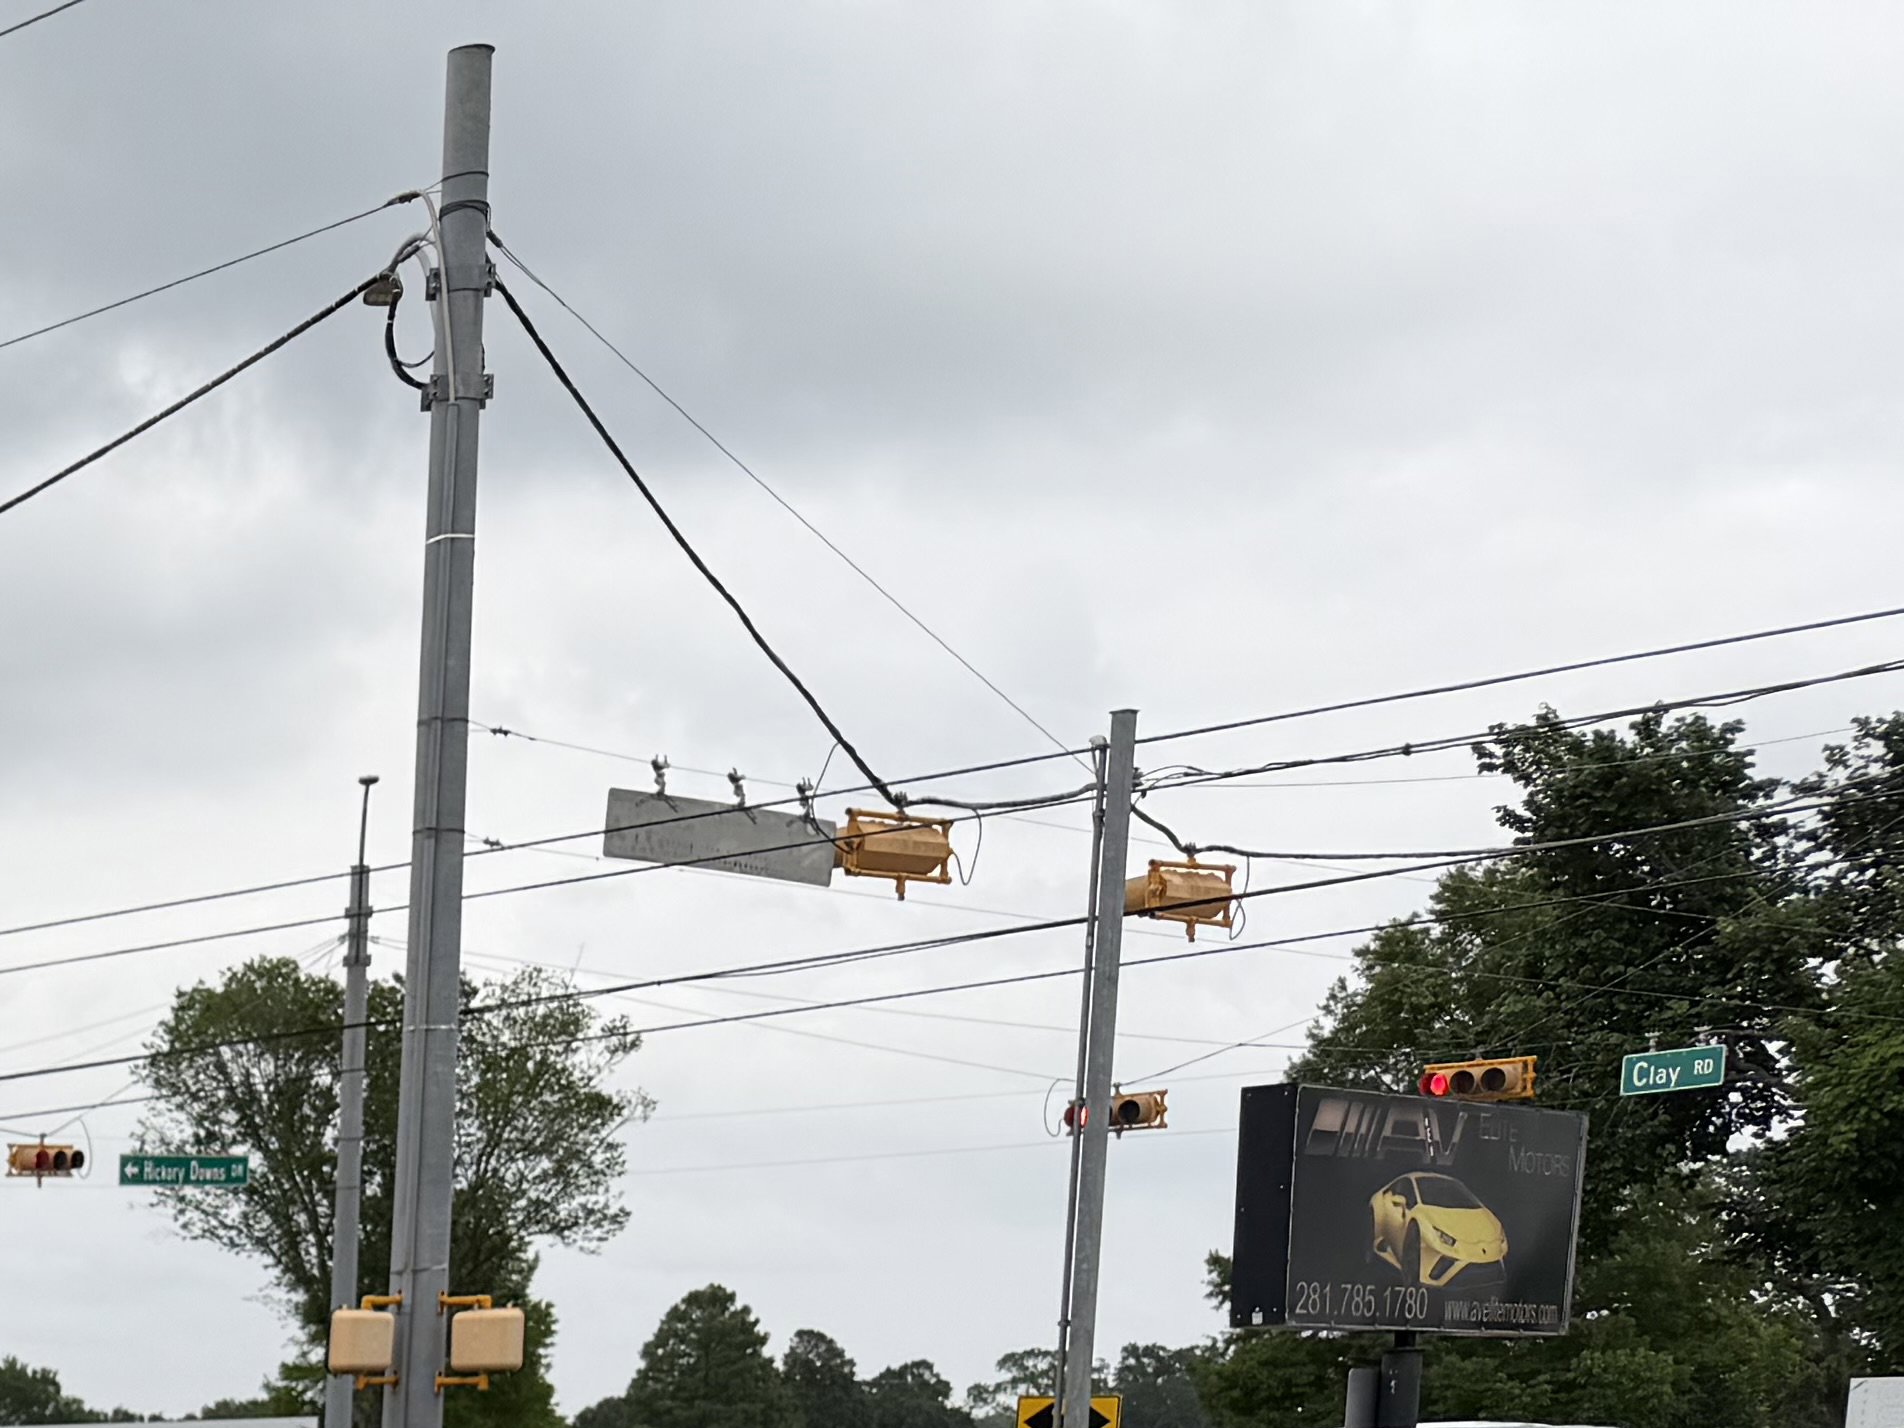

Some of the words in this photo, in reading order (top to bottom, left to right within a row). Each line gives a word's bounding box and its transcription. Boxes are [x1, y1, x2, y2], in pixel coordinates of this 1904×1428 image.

[1633, 1061, 1680, 1088] Clay
[1693, 1058, 1714, 1075] RD
[143, 1160, 185, 1184] Hickory
[189, 1160, 226, 1181] Downs
[1507, 1145, 1572, 1178] MOTORS
[1295, 1281, 1428, 1320] 281.785.1780
